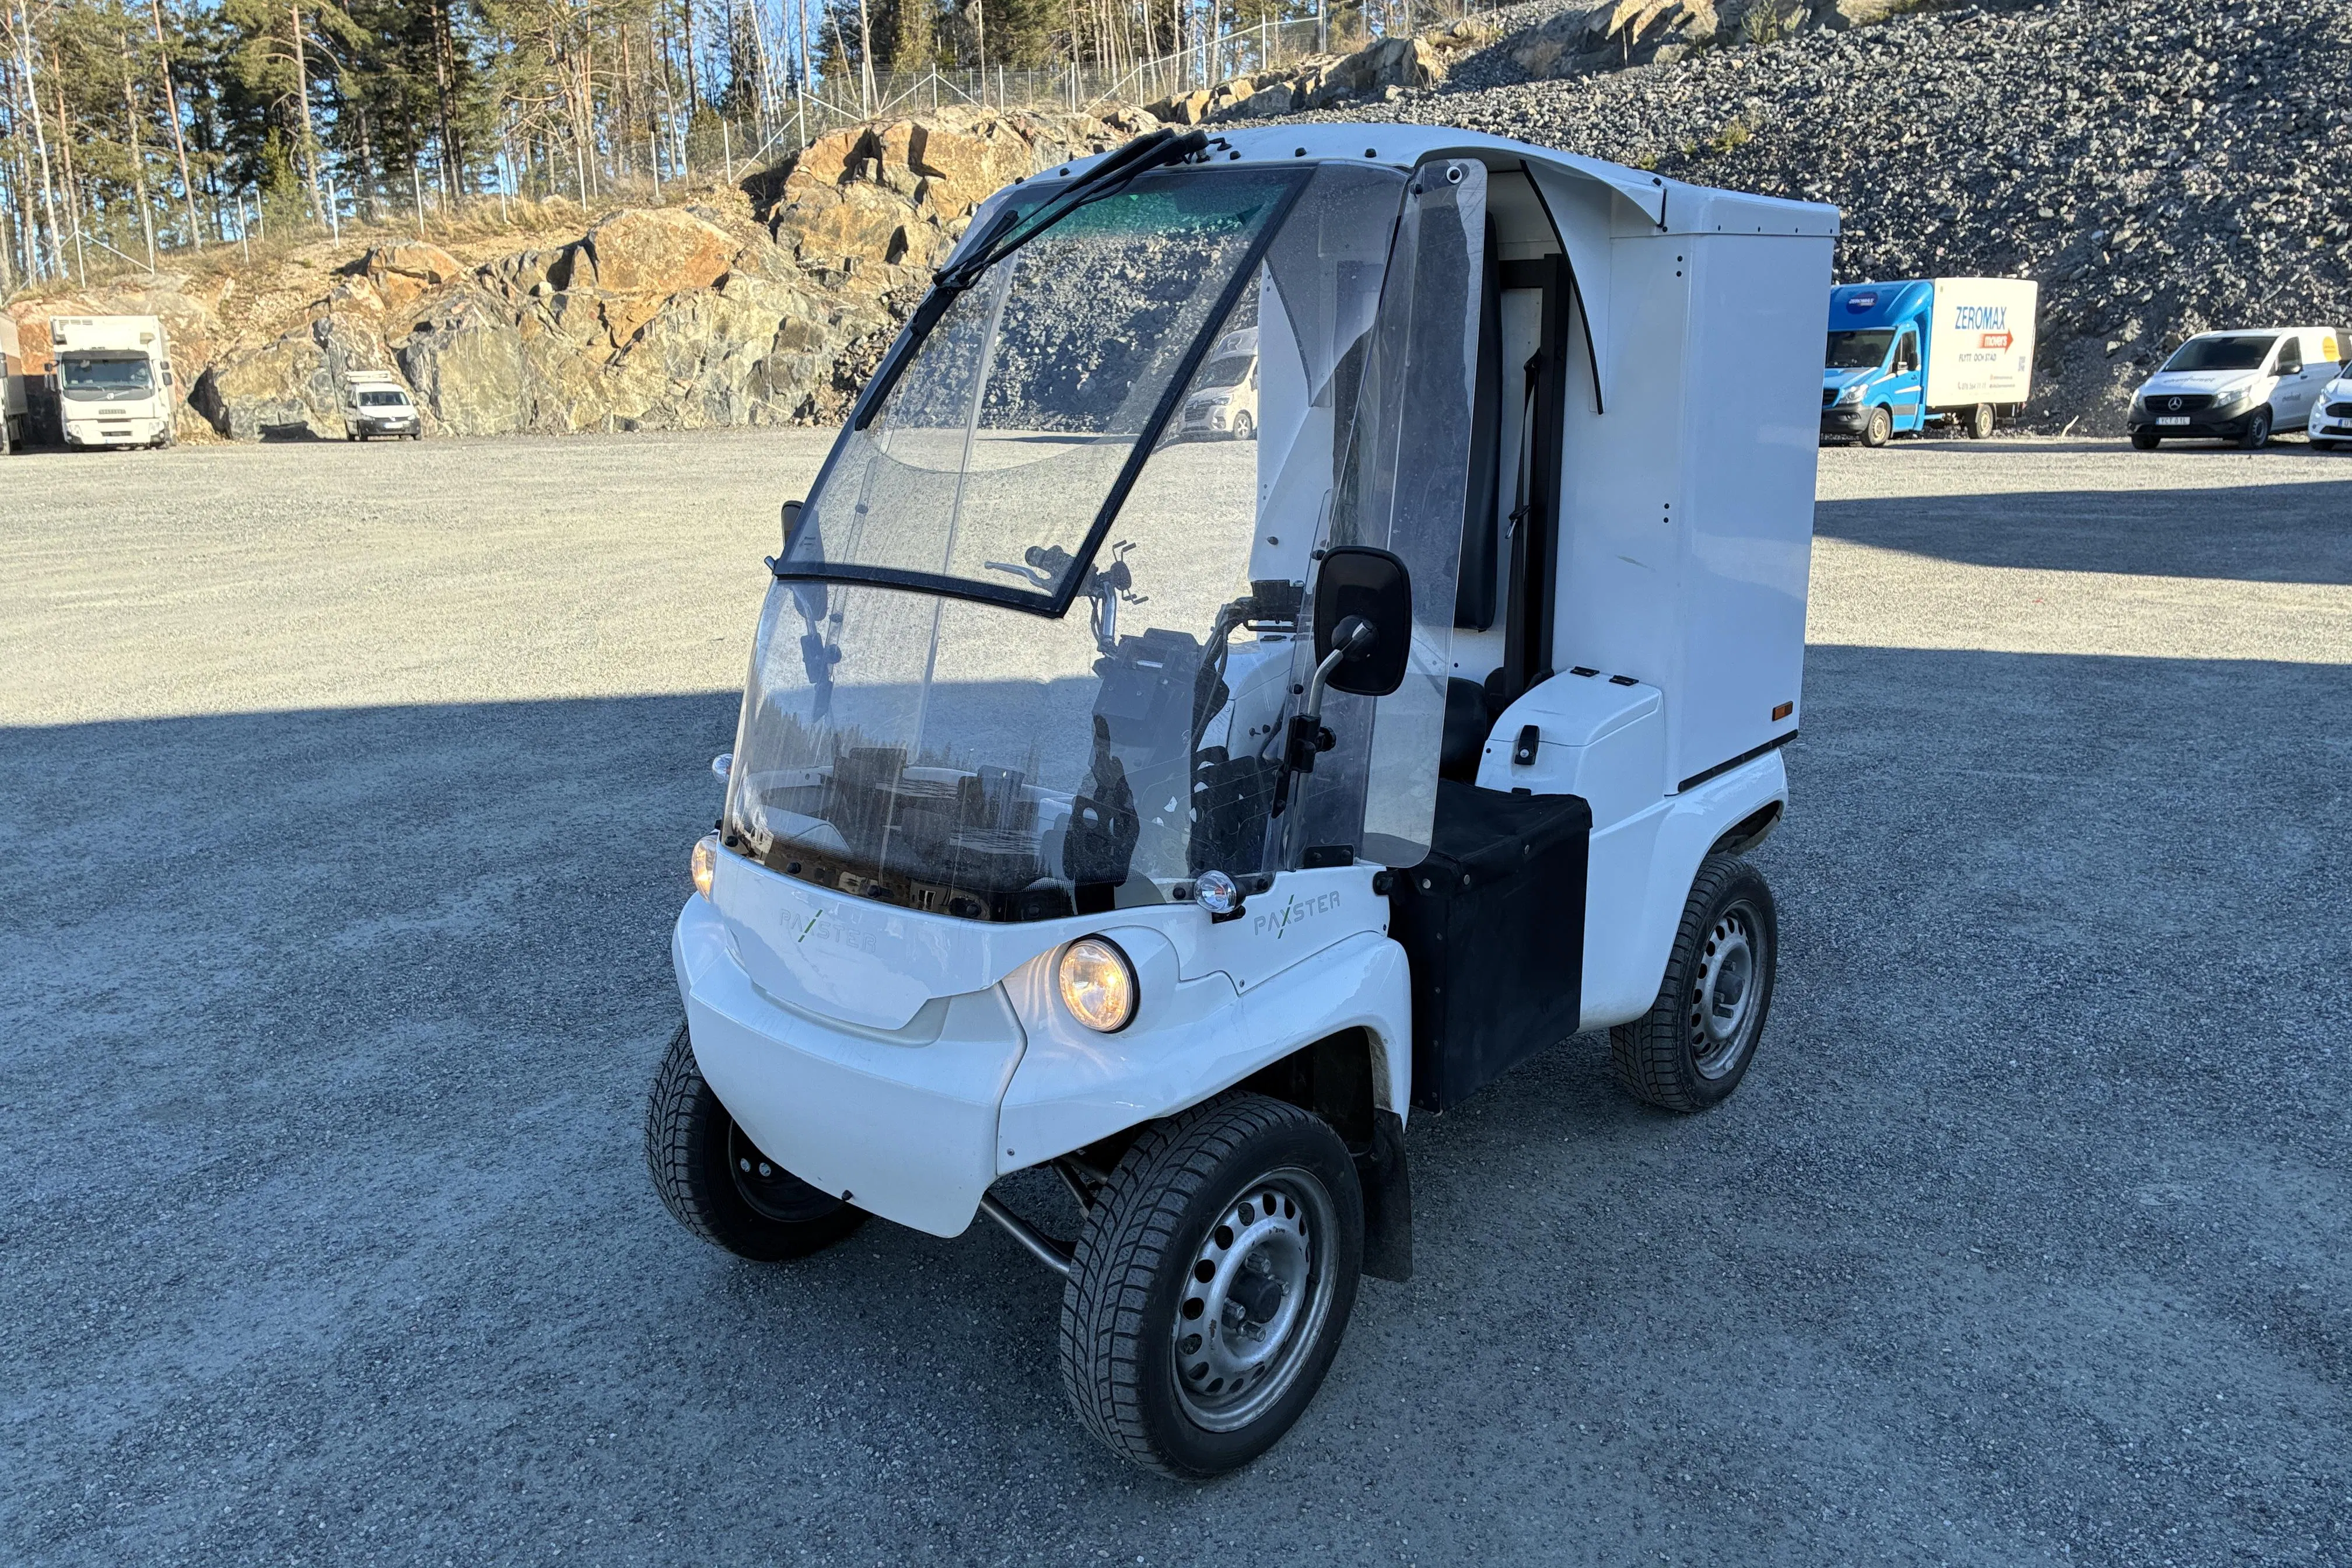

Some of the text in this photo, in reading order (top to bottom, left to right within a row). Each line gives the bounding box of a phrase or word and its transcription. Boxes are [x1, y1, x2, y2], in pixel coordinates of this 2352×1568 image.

[1955, 306, 2007, 330] ZEROMAX
[1985, 335, 2008, 347] movers
[1959, 353, 1972, 362] FLYTT
[1254, 891, 1340, 939] PAXSTER
[779, 909, 877, 954] PAXSTER
